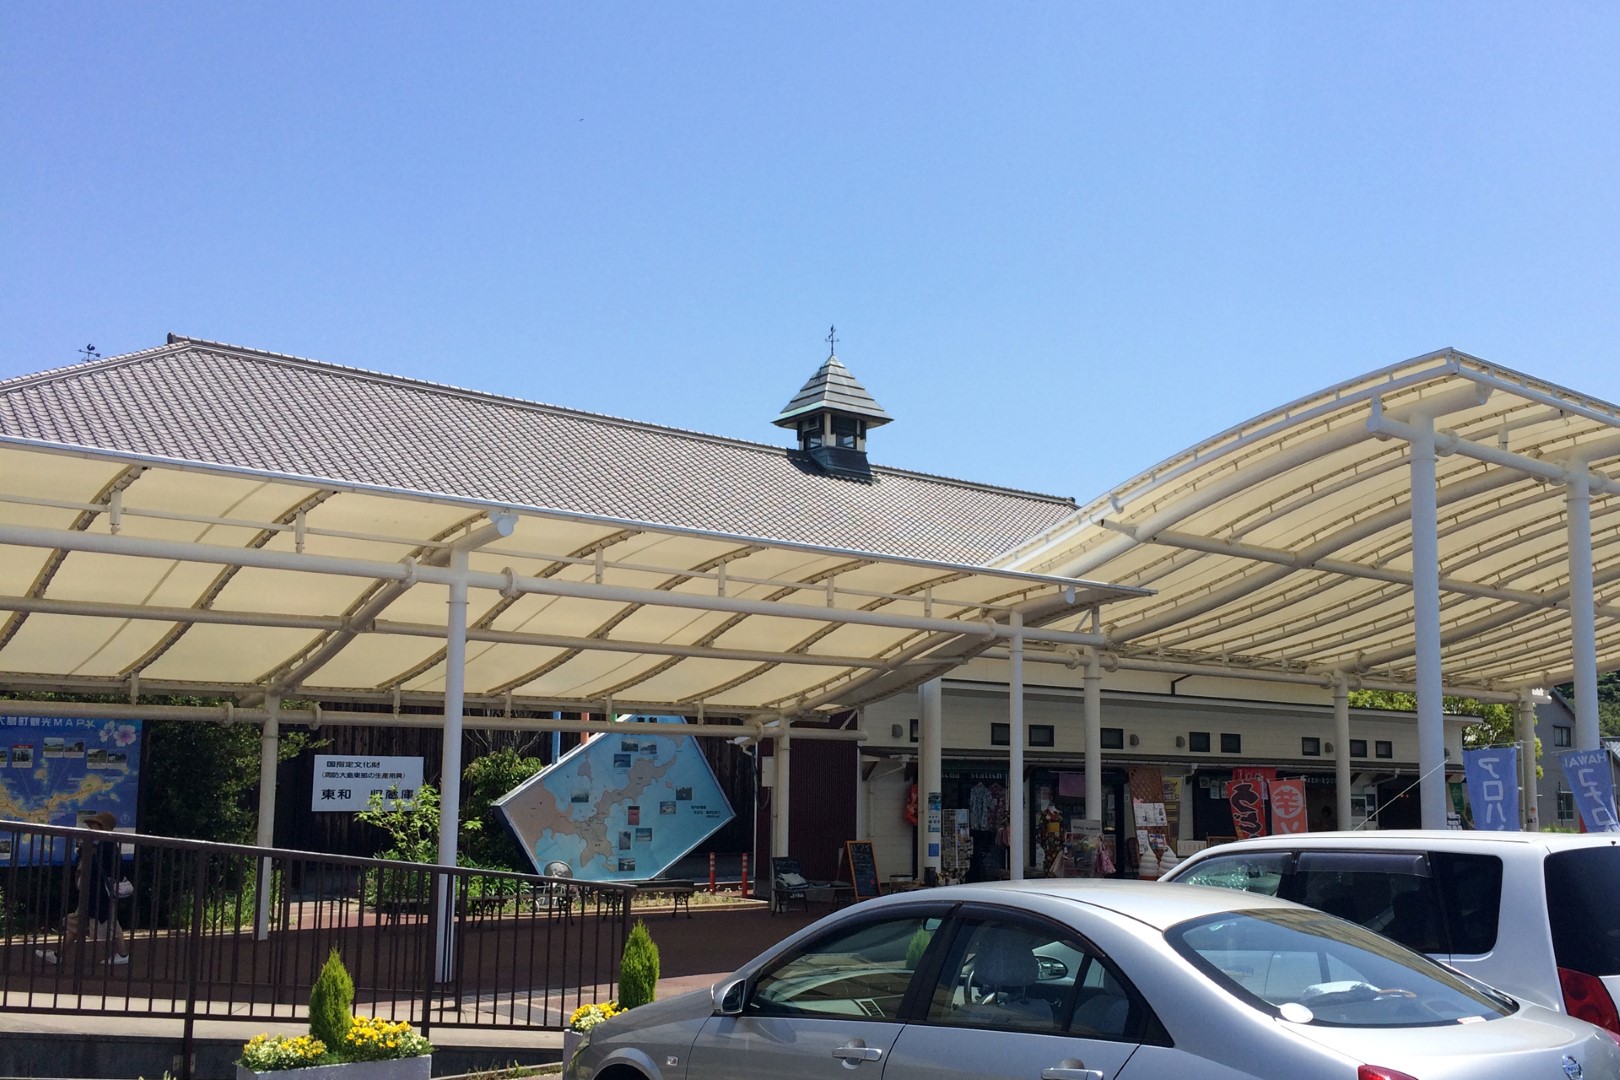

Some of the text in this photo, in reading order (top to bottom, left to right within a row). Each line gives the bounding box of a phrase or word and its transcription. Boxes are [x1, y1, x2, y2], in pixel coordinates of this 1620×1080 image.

[326, 760, 381, 769] 国指定文化財
[321, 788, 352, 800] 東和
